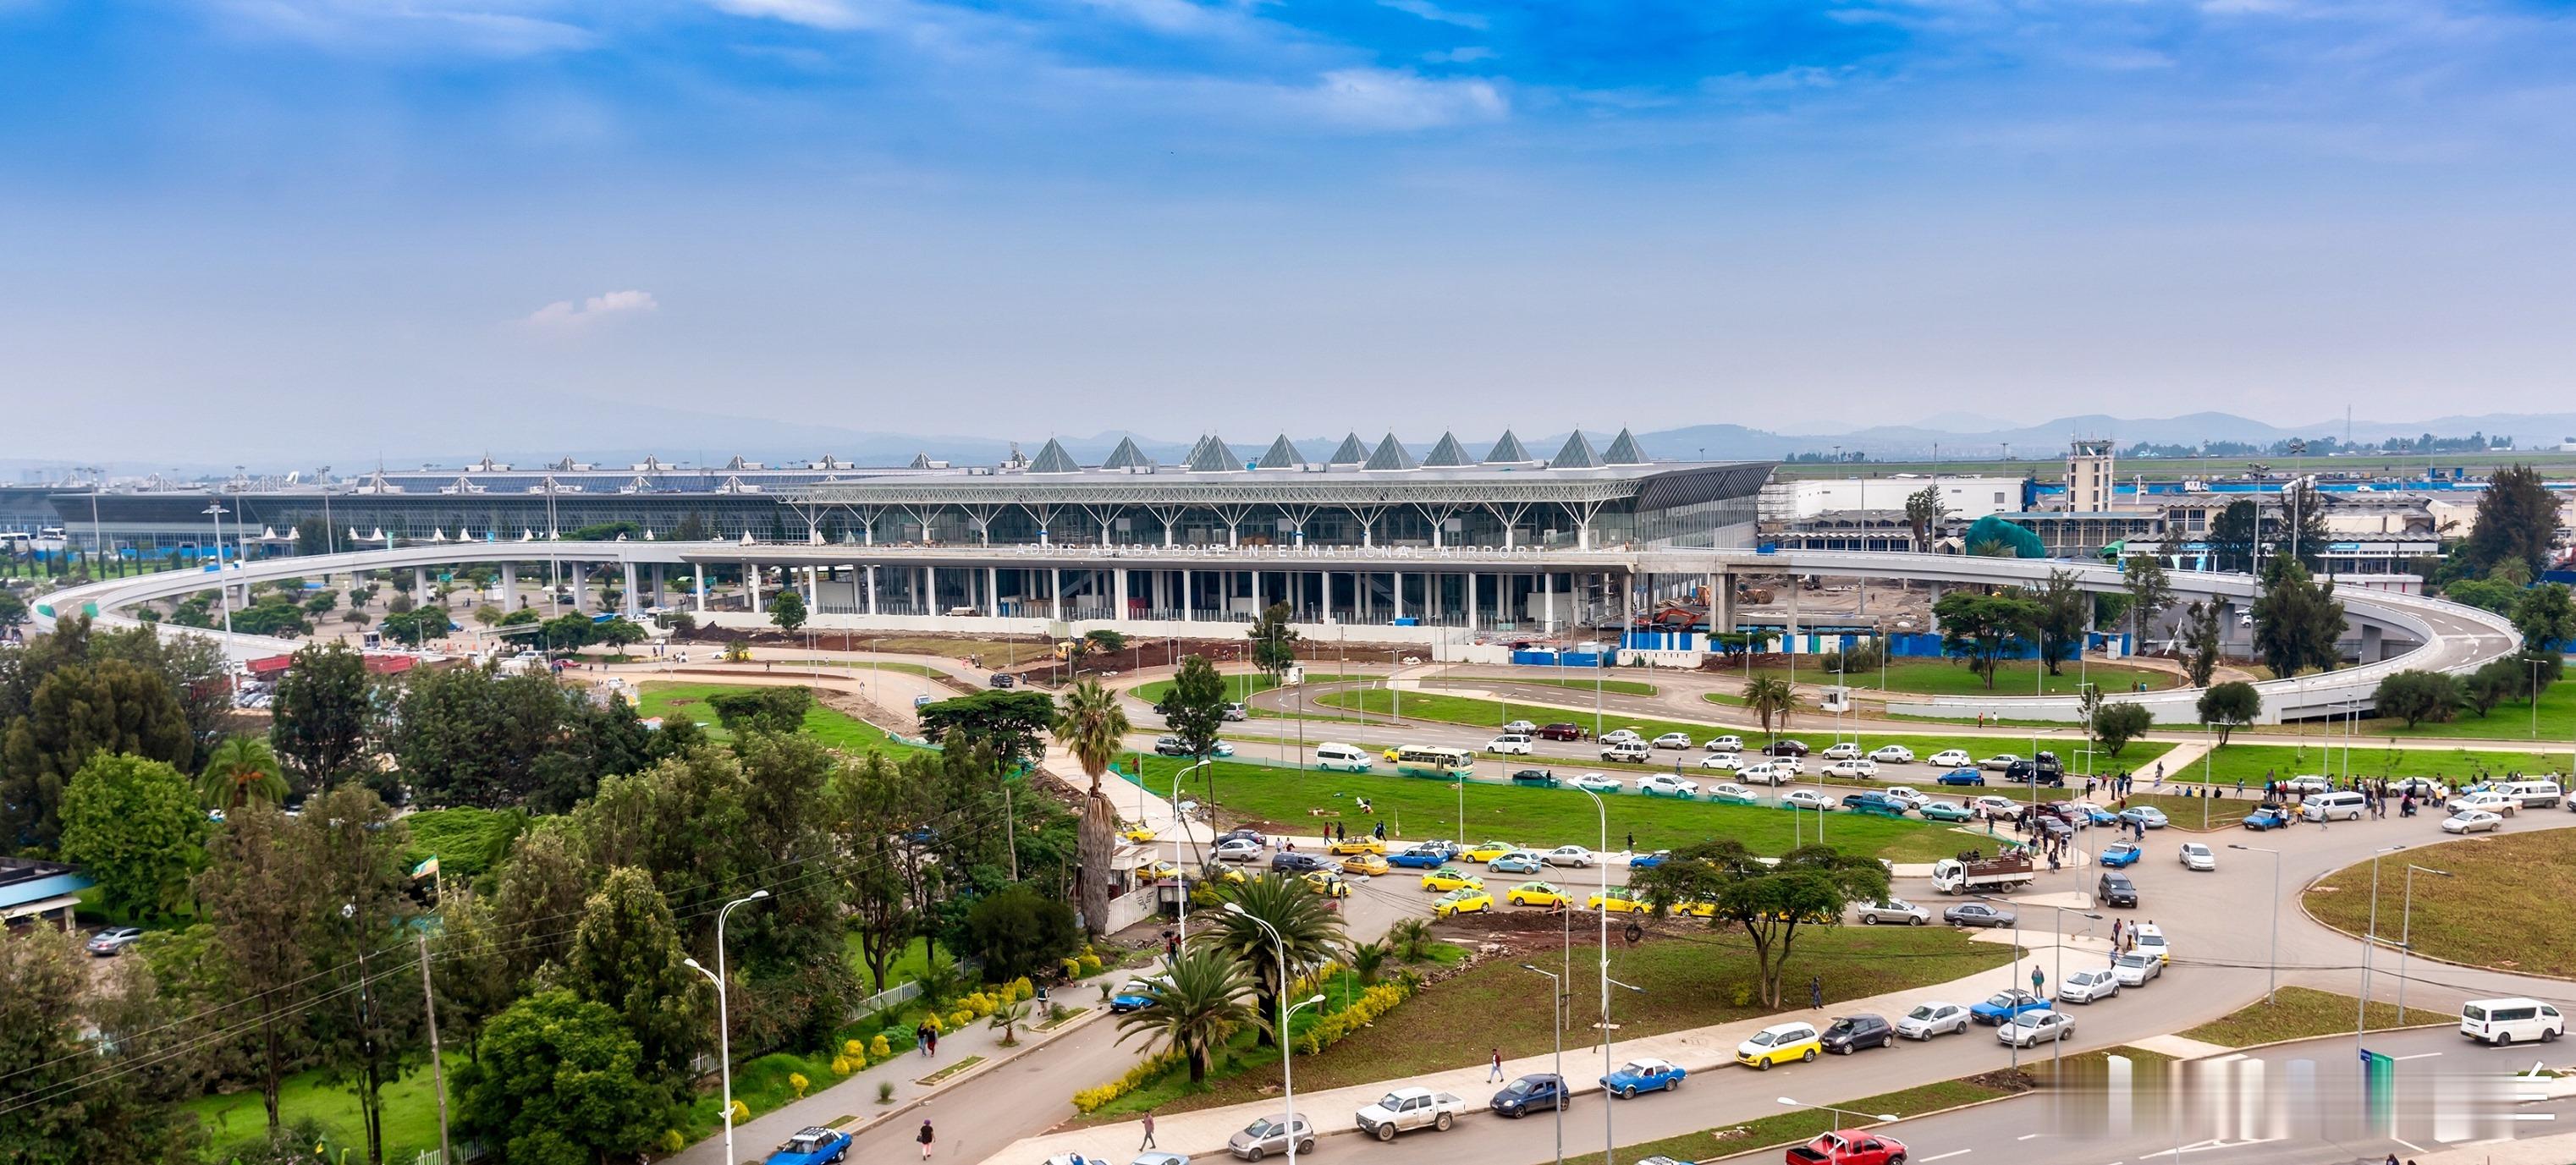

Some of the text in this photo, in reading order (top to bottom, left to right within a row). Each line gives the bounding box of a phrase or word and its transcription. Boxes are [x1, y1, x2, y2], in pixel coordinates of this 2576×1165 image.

[1016, 543, 1545, 559] ADDIS ABABA BOLE INTERNATIONAL AIRPORT
